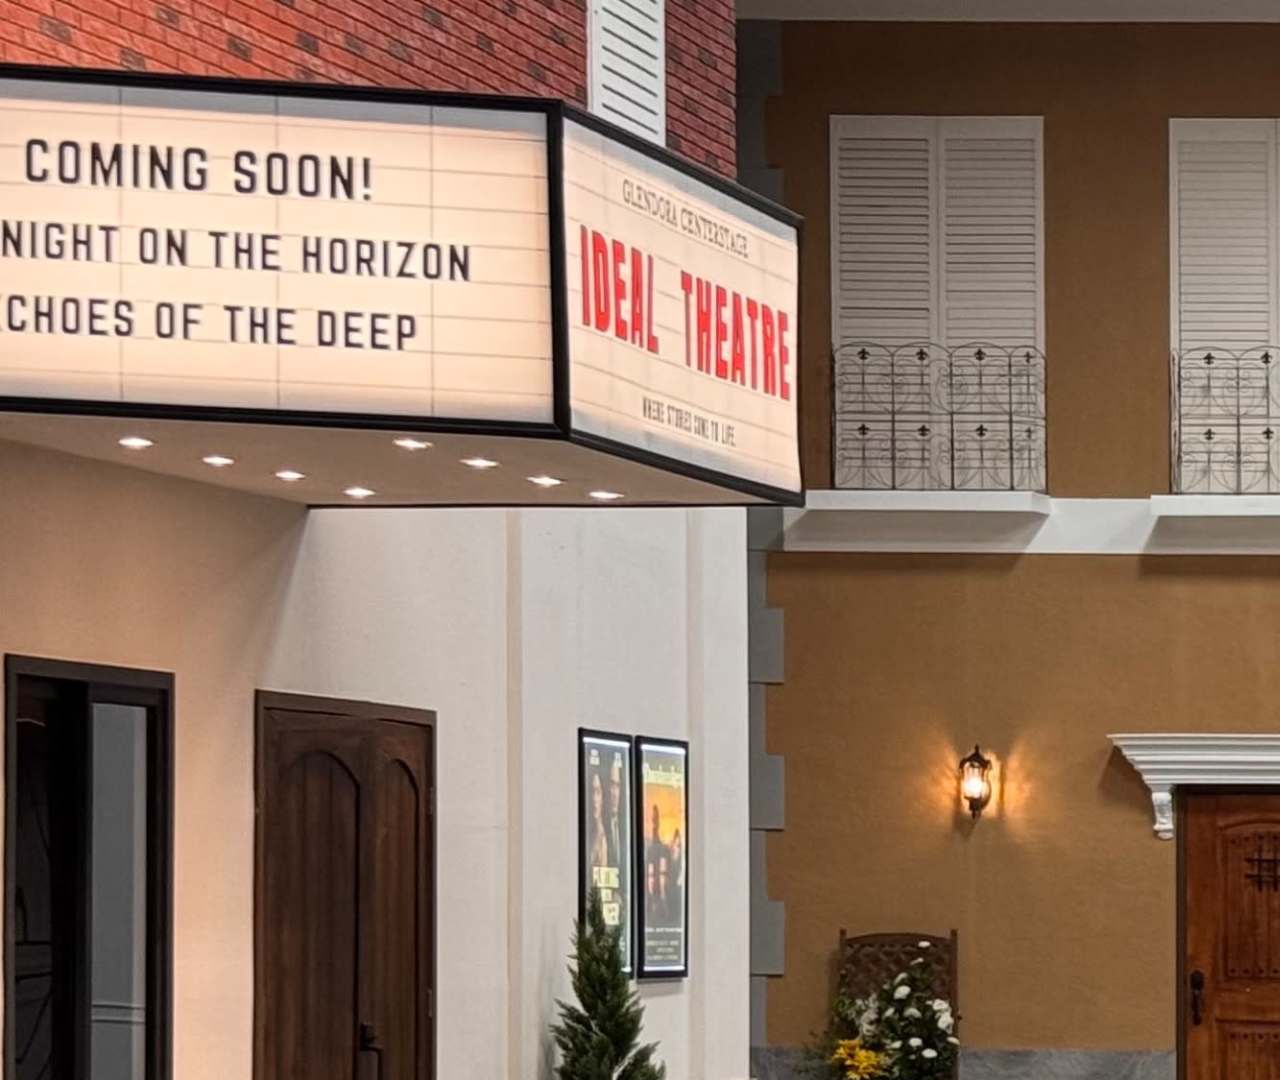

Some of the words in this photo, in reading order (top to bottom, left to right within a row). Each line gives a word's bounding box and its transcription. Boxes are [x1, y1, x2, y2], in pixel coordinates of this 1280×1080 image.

[25, 139, 209, 192] COMING
[233, 151, 373, 200] SOON!
[622, 178, 678, 227] GLENDORA
[680, 207, 749, 259] CENTERSTAGE
[1, 219, 120, 262] NIGHT
[139, 228, 188, 266] ON
[208, 231, 282, 272] THE
[301, 236, 472, 282] HORIZON
[0, 294, 134, 337] CHOES
[155, 302, 204, 340] OF
[223, 305, 298, 345] THE
[317, 310, 418, 351] DEEP
[580, 224, 660, 354] IDEAL
[680, 270, 791, 400] THEATRE
